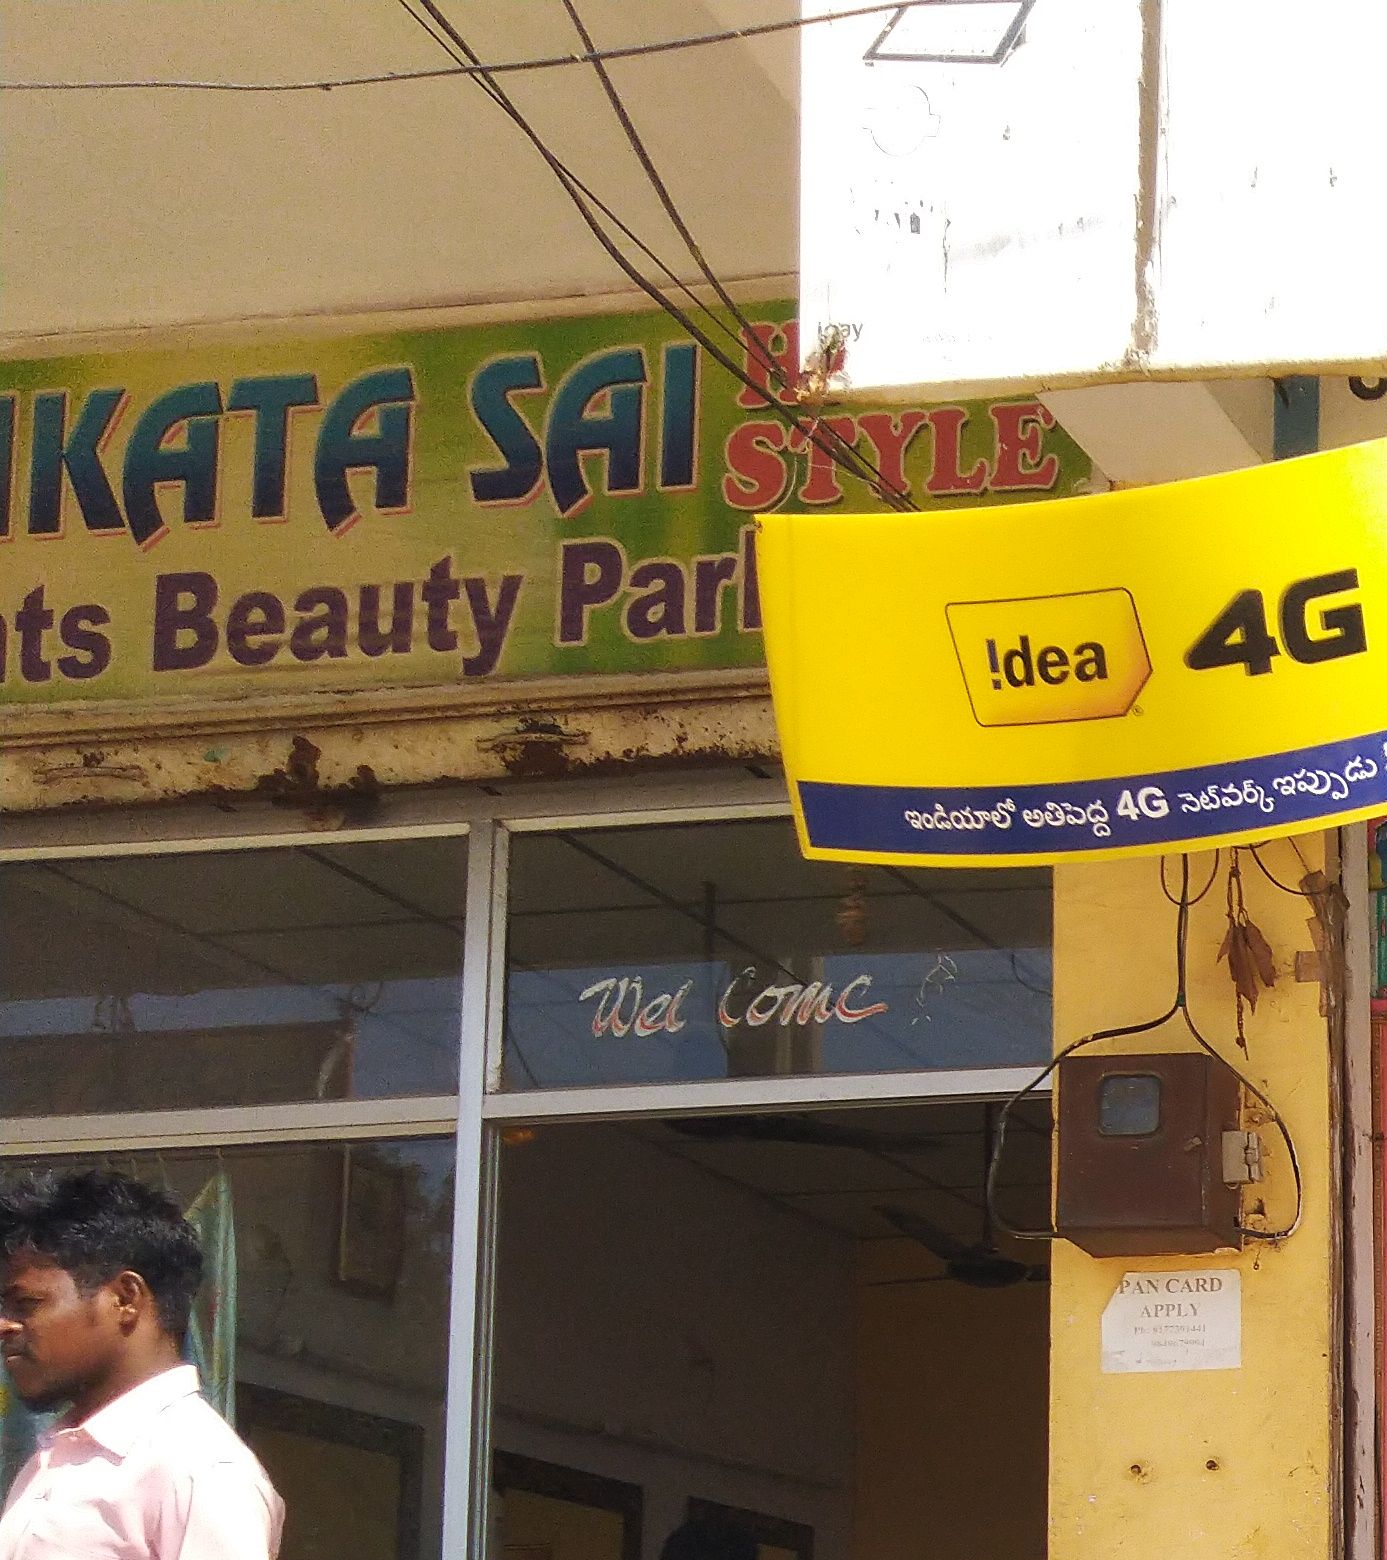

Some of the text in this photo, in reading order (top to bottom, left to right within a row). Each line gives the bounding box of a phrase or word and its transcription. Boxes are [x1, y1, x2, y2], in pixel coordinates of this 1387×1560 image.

[468, 340, 699, 517] SAI
[724, 403, 1060, 510] STYLE
[0, 585, 112, 683] ts
[152, 556, 522, 676] Beauty
[1184, 568, 1369, 677] 4G
[904, 798, 1016, 832] ఇండియాలో
[1116, 786, 1170, 822] 4G
[1273, 755, 1378, 800] ఇప్పుడు
[1119, 1277, 1223, 1295] PAN CARD
[1140, 1303, 1200, 1318] APPLY
